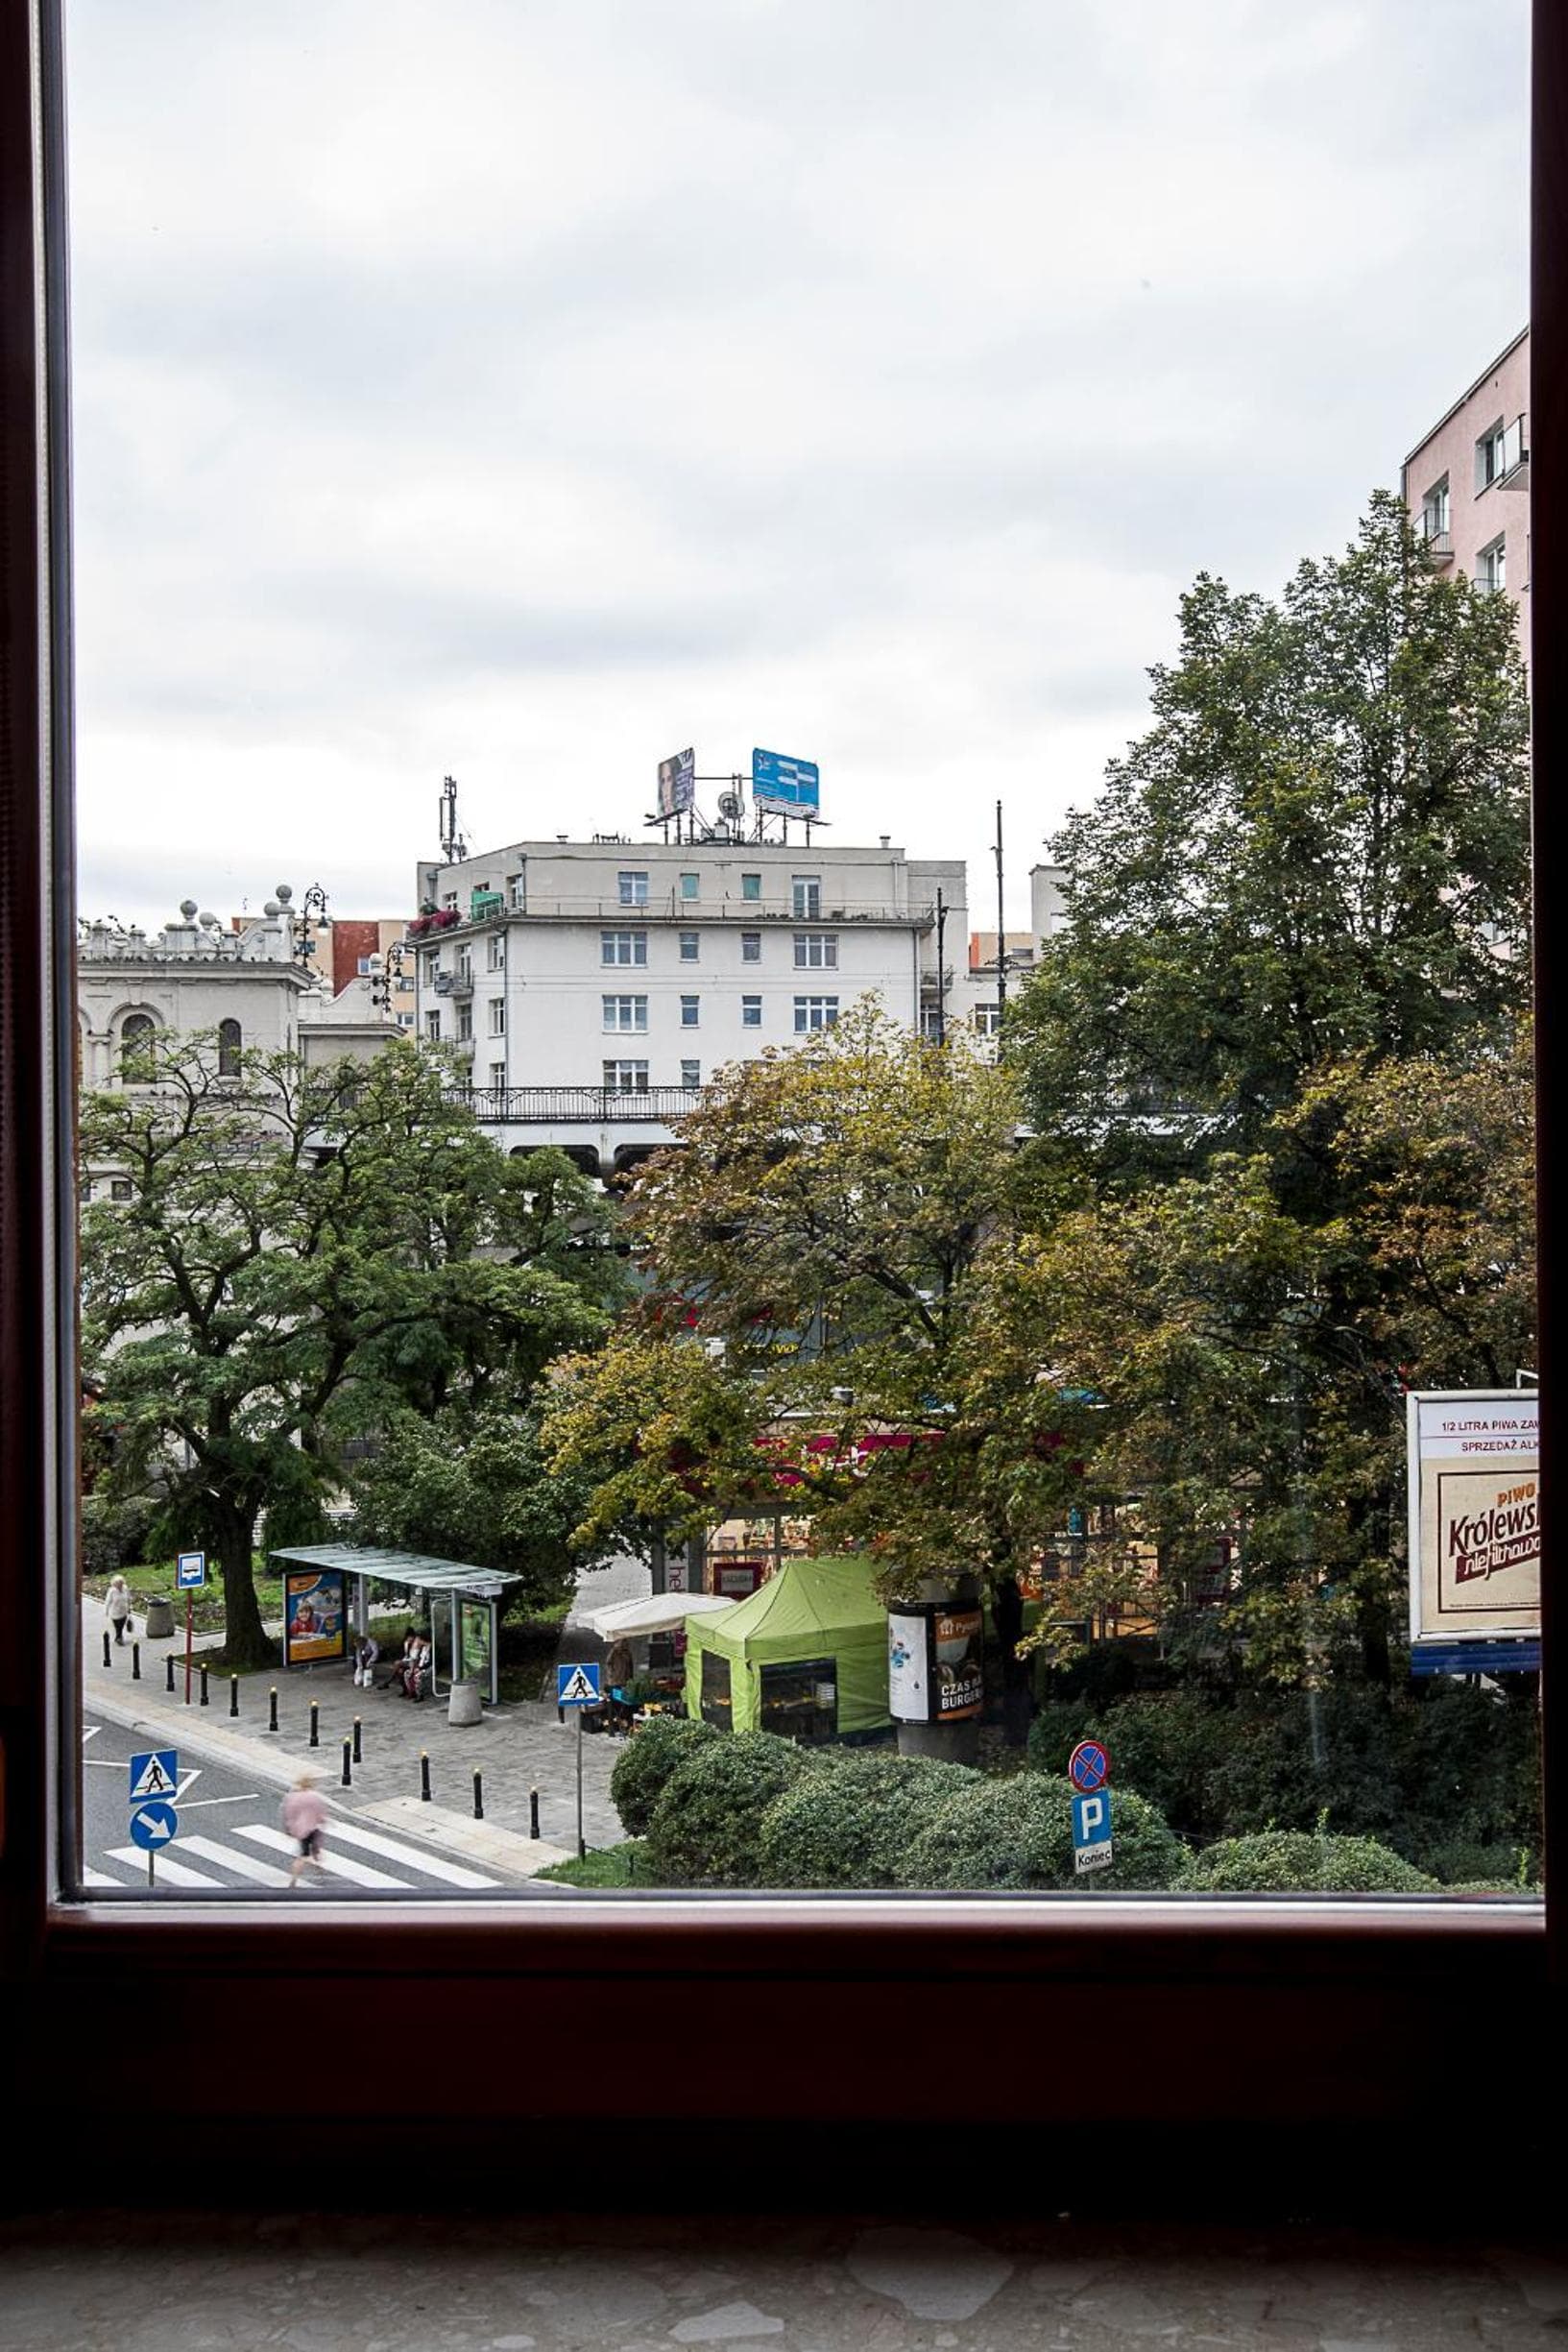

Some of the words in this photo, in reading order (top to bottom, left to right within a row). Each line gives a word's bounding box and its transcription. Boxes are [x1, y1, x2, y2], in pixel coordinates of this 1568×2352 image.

[1442, 1422, 1456, 1431] 1/2
[1459, 1420, 1488, 1431] LITRA
[1492, 1419, 1518, 1429] PIWA
[1461, 1439, 1516, 1451] SPRZEDAŻ
[1497, 1483, 1535, 1507] PIWO
[1449, 1503, 1540, 1558] Królews
[941, 1681, 970, 1697] CZAS
[1081, 1798, 1103, 1840] P
[1077, 1849, 1111, 1868] Koniec
